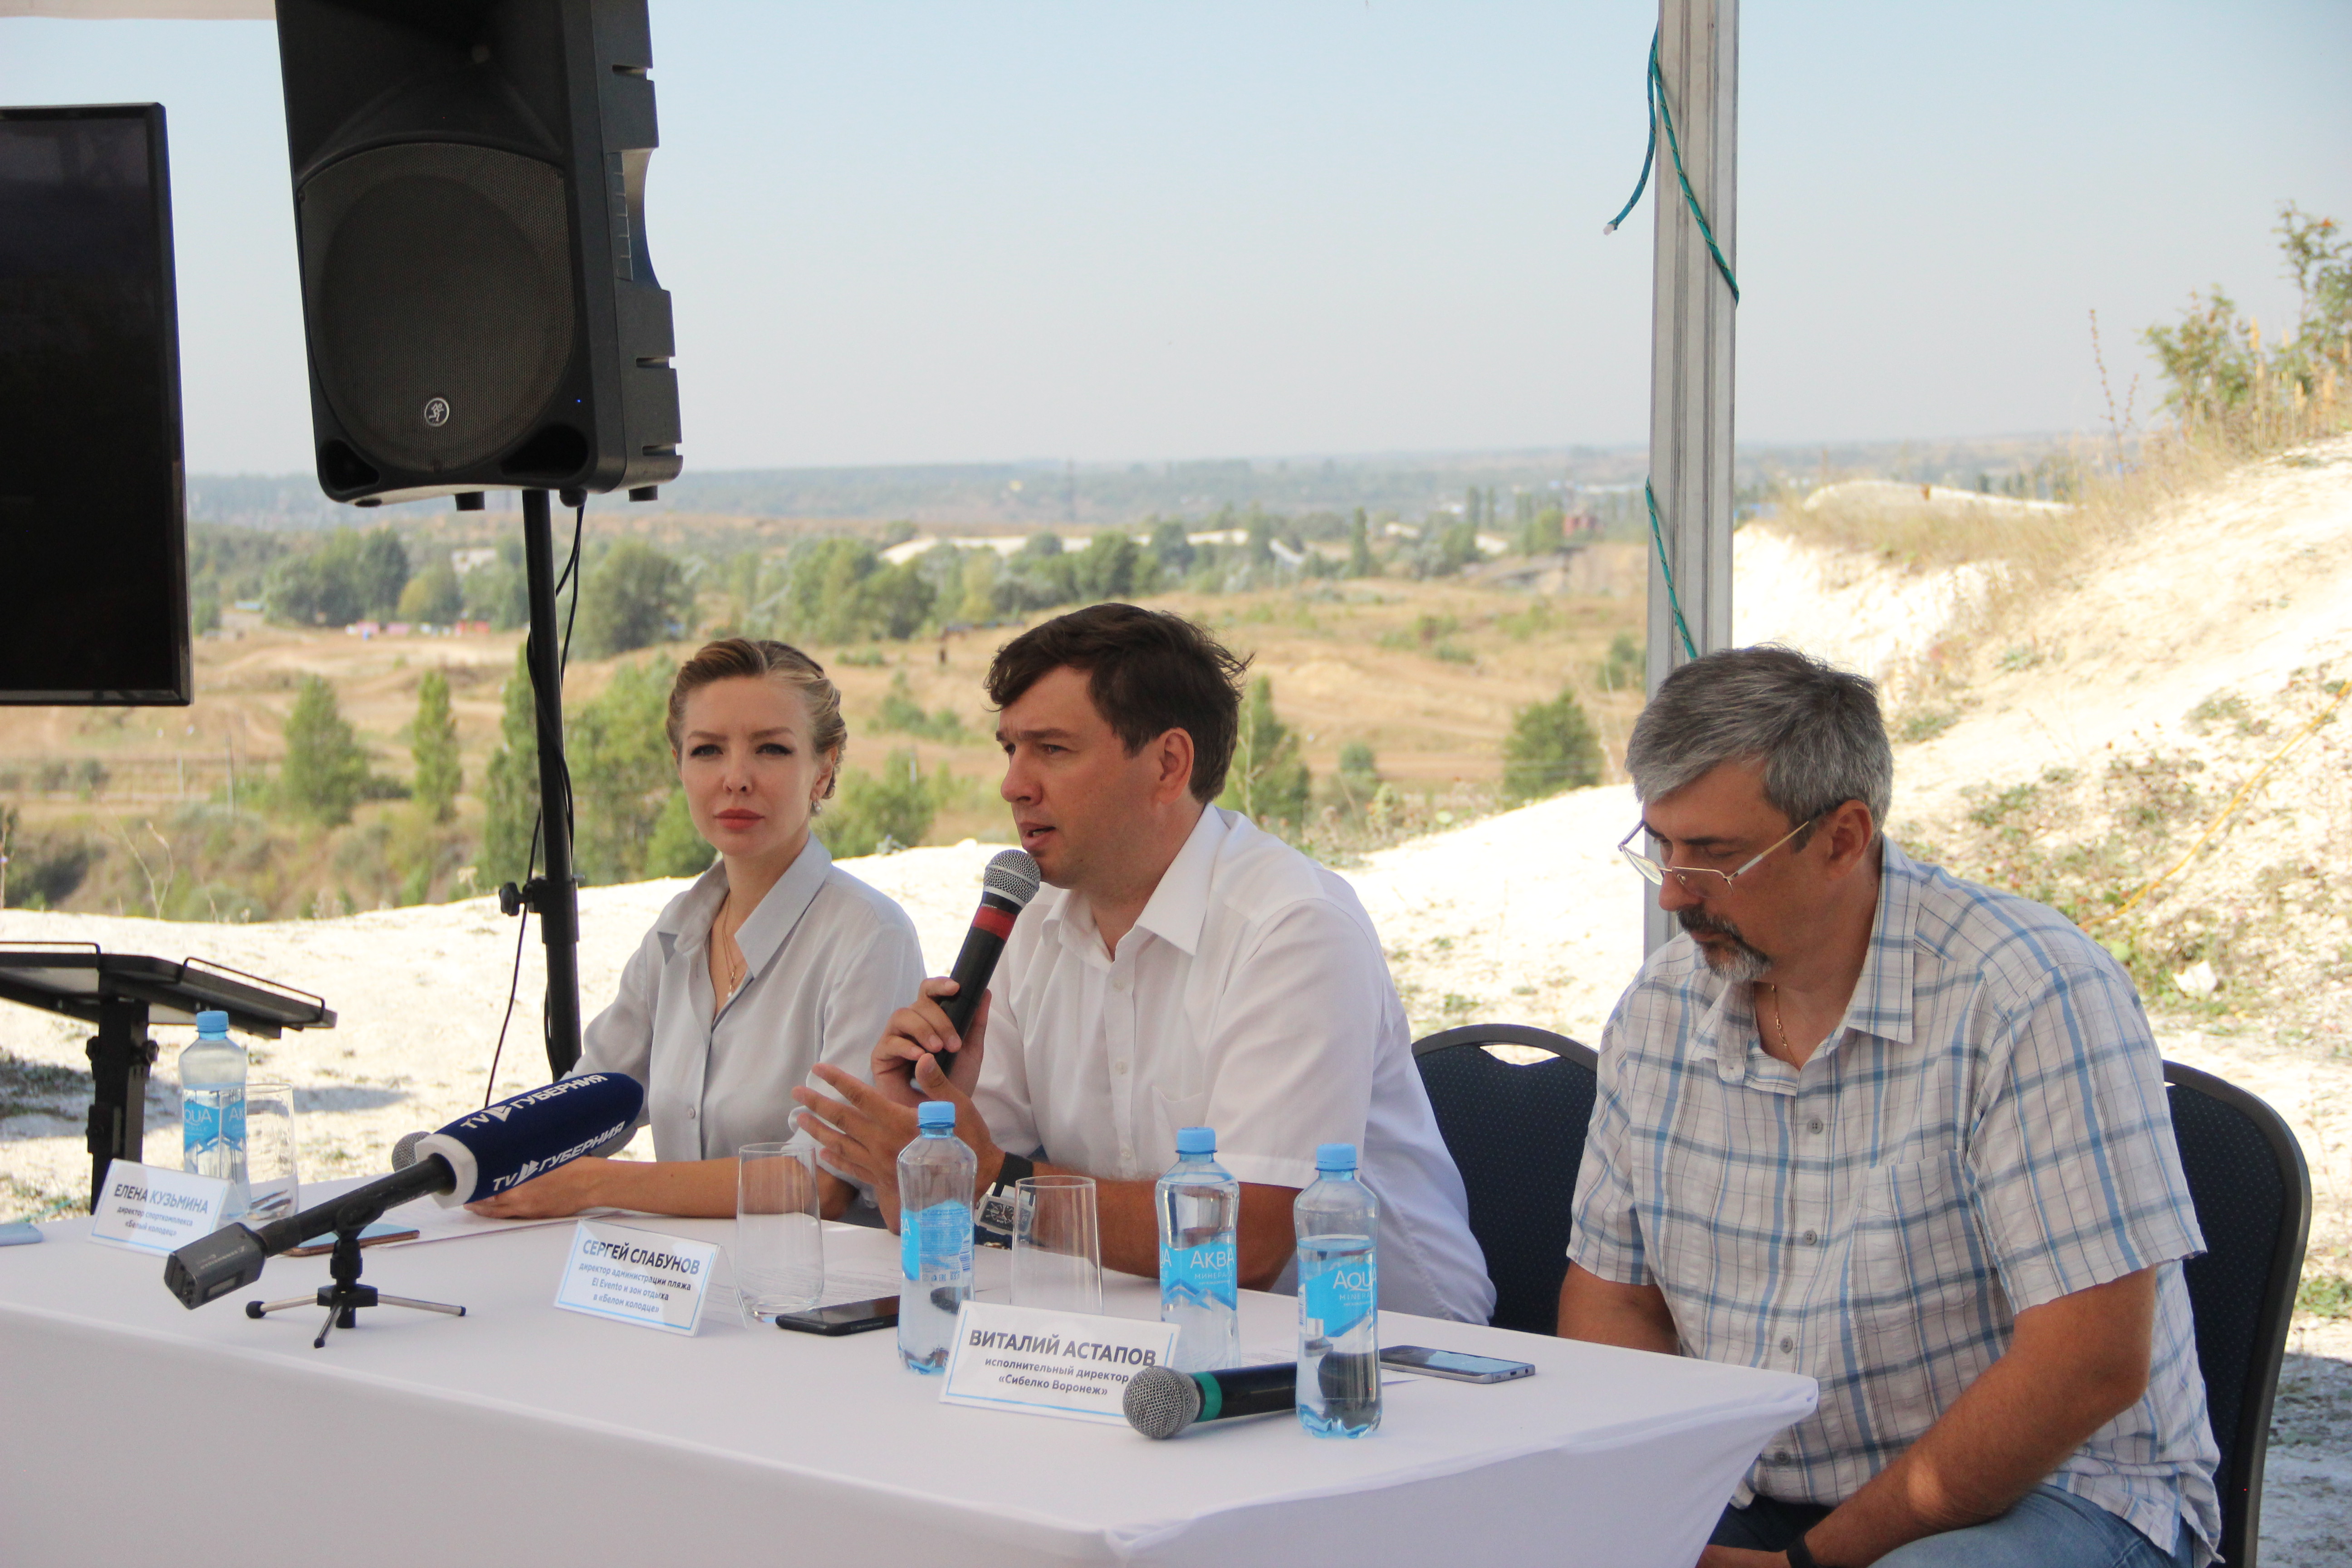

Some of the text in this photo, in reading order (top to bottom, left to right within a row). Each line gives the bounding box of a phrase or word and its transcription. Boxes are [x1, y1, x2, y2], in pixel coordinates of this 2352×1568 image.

[461, 1074, 608, 1129] TV ГУБЕРНИЯ
[185, 1108, 212, 1126] QUA
[493, 1121, 625, 1191] TV ГУБЕРНИЯ
[114, 1184, 208, 1214] ЕЛЕНА КУЗЬМИНА
[117, 1206, 193, 1227] директор спорткомплекса
[125, 1220, 176, 1236] «Белый колодец»
[583, 1240, 700, 1274] СЕРГЕЙ СЛАБУНОВ
[1190, 1247, 1235, 1270] АКВА
[579, 1263, 691, 1291] директор администрации пляжа
[1333, 1267, 1377, 1291] AQUA
[592, 1278, 598, 1286] El
[599, 1279, 622, 1291] Evento
[629, 1286, 642, 1295] зон
[643, 1290, 669, 1301] отдыха
[599, 1294, 624, 1305] «Белом
[625, 1301, 659, 1313] колодце»
[969, 1329, 1156, 1367] ВИТАЛИЙ АСТАПОВ
[985, 1358, 1129, 1384] исполнительный директор
[998, 1374, 1108, 1396] «Сибелко Воронеж»
